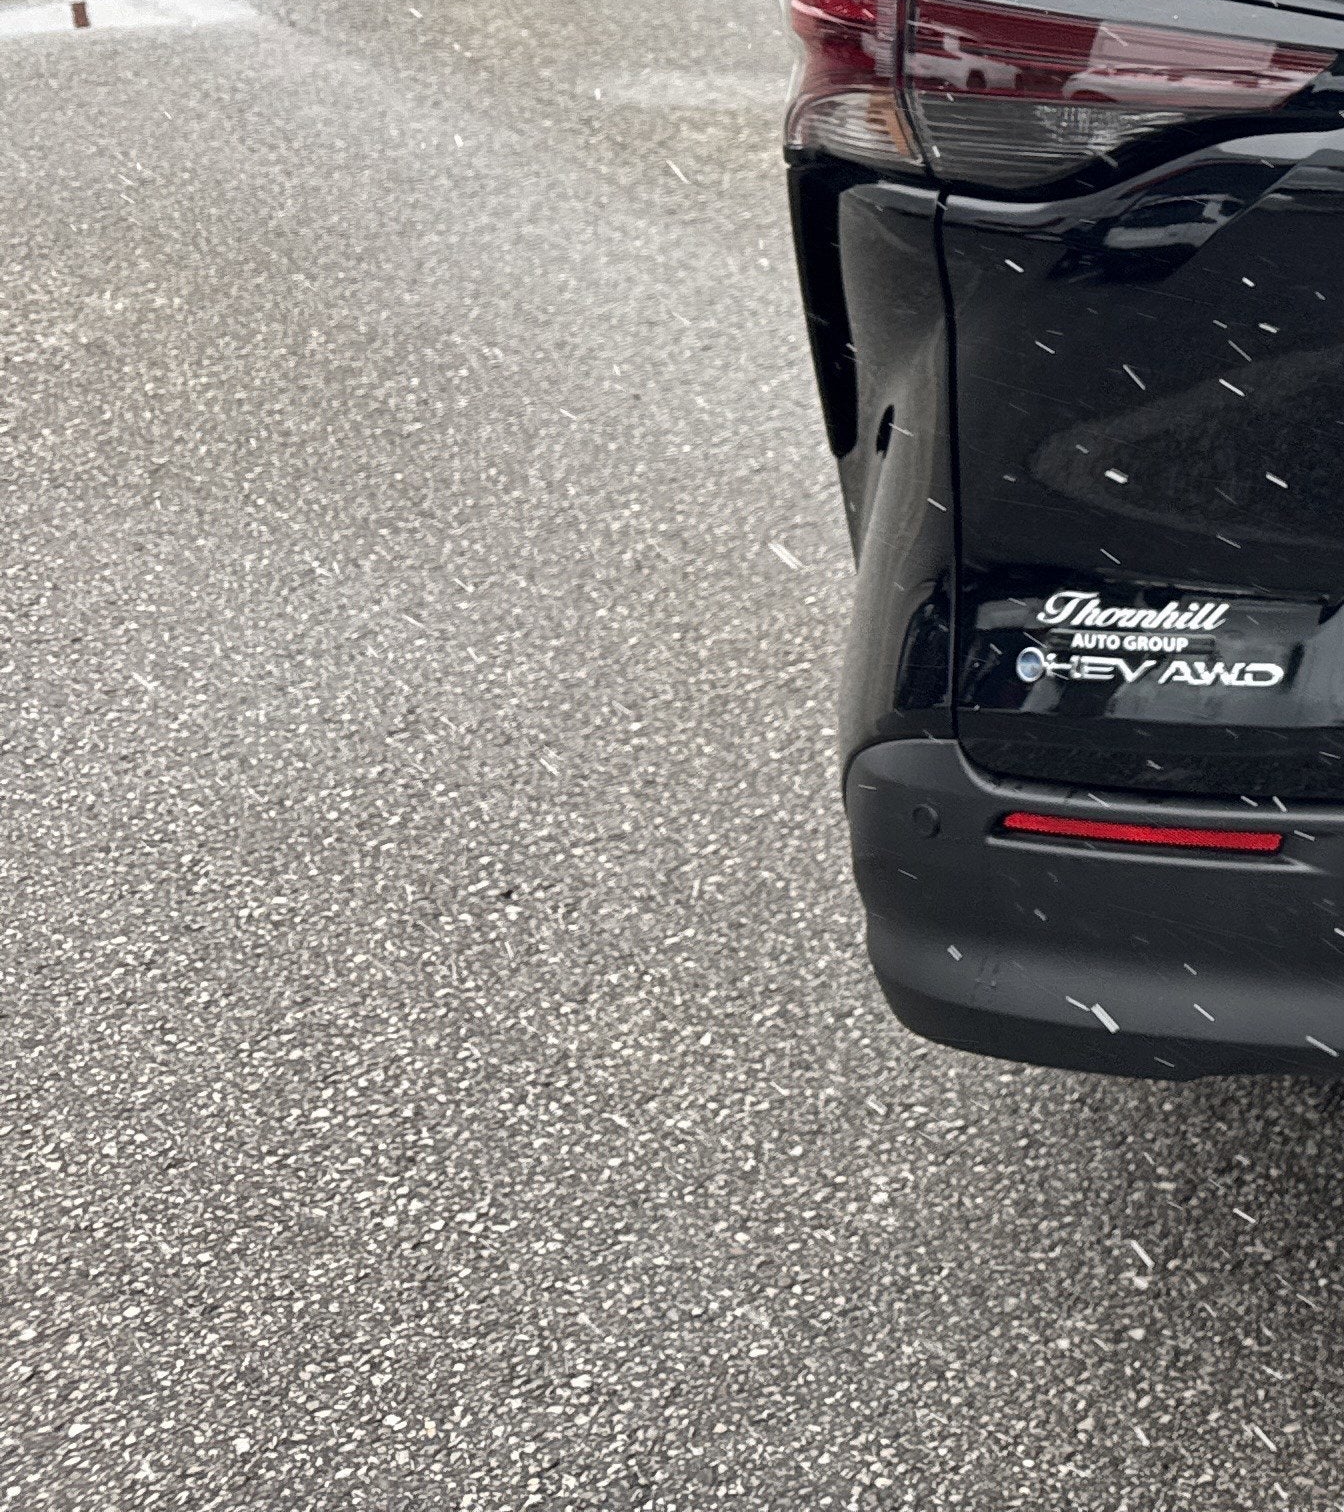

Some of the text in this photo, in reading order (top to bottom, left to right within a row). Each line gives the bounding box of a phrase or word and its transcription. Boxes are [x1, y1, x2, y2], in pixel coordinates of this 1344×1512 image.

[1036, 591, 1230, 631] Thornhill
[1070, 632, 1190, 654] AUTO GROUP
[1157, 660, 1285, 688] AWD
